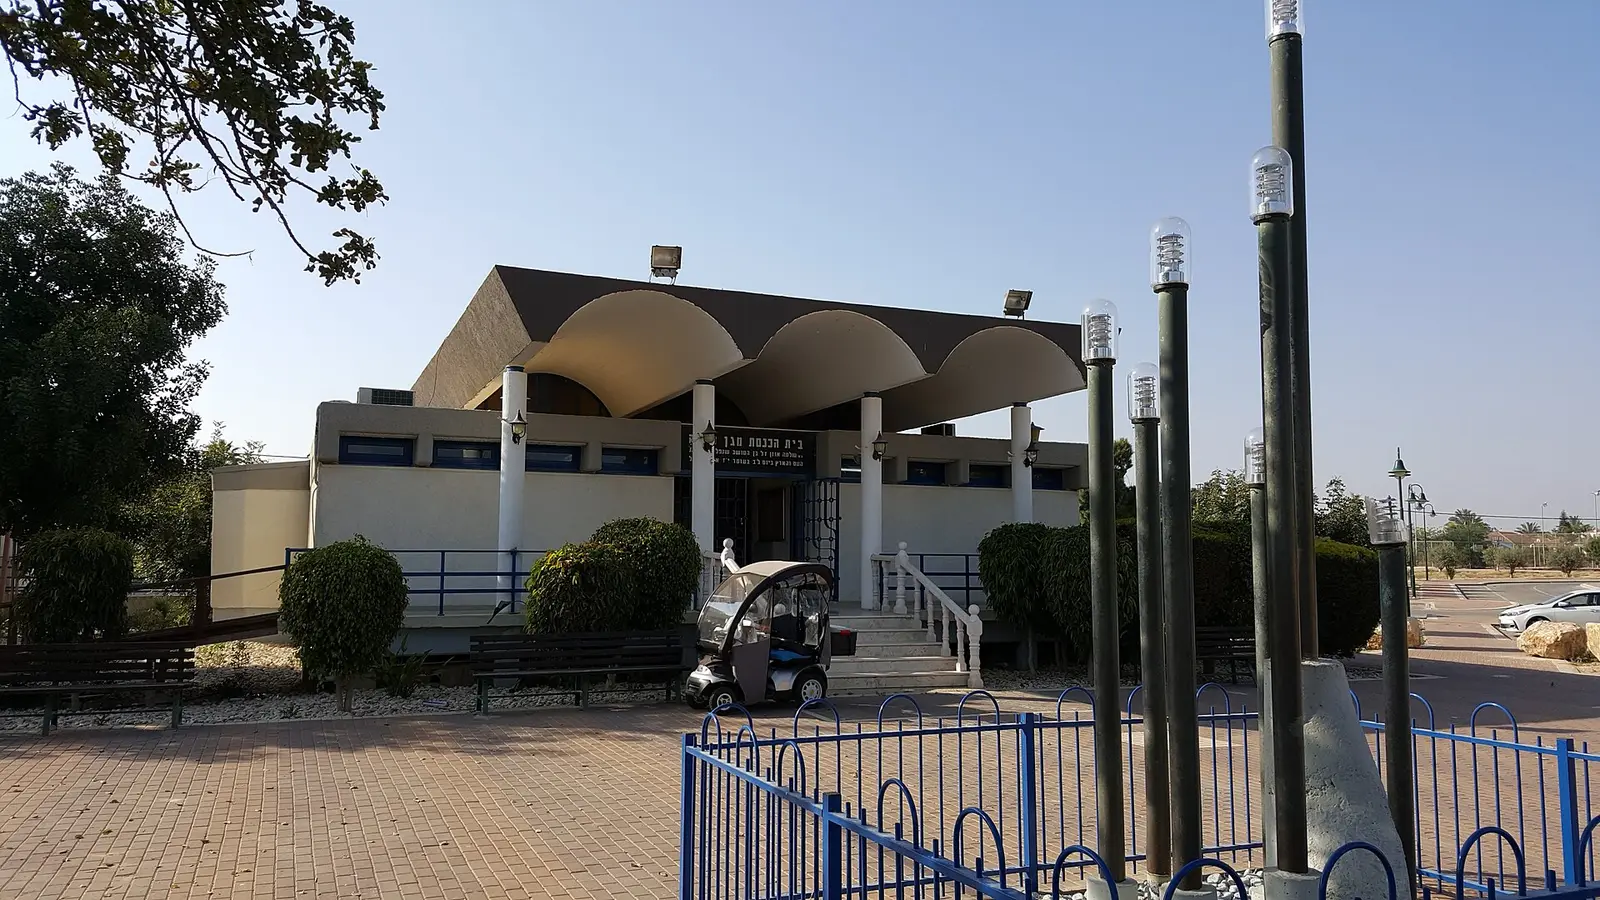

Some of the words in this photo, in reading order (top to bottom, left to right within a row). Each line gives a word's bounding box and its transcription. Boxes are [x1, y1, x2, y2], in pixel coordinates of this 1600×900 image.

[724, 436, 742, 448] מגן
[749, 437, 779, 448] הכנסת
[785, 439, 803, 449] בית
